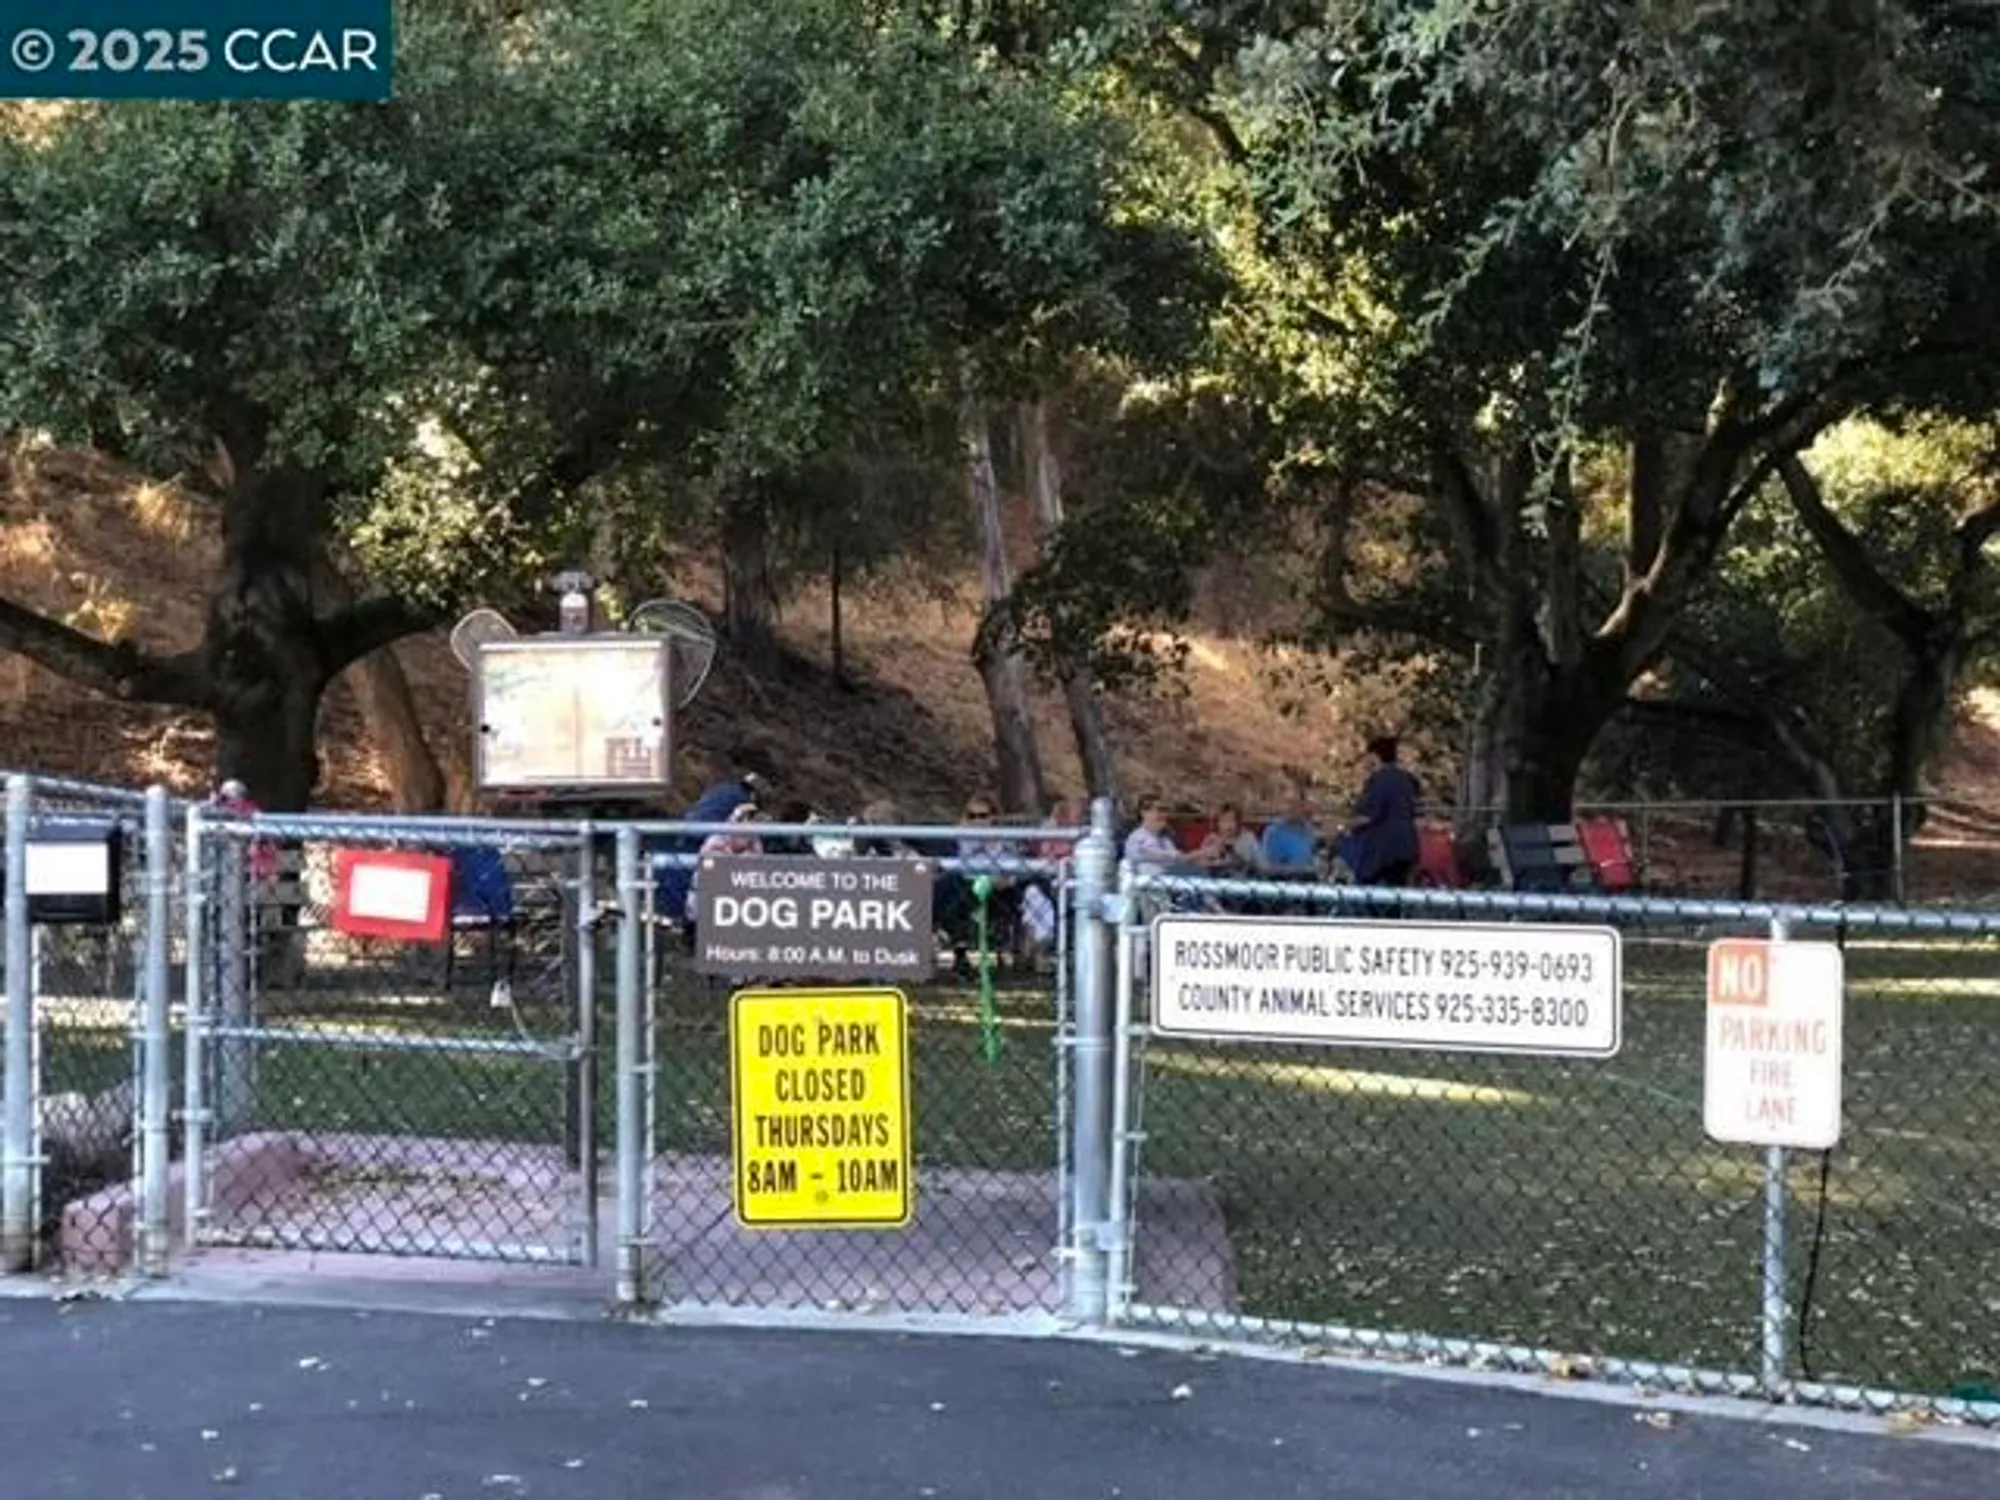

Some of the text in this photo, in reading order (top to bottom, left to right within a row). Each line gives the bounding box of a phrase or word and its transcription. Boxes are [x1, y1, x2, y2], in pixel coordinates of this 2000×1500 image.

[730, 871, 899, 892] WELCOME TO THE
[713, 897, 913, 931] DOG PARK
[852, 948, 871, 965] to
[874, 947, 919, 966] Dusk
[1174, 940, 1593, 983] ROSSMOOR PUBLIC SAFETY 925-939-0693
[1718, 954, 1763, 998] NO
[1178, 982, 1589, 1027] COUNTY ANIMAL SERVICES 925-335-8300
[758, 1023, 880, 1057] DOG PARK
[1718, 1015, 1827, 1055] PARKING
[775, 1068, 865, 1101] CLOSED
[1750, 1059, 1792, 1089] FIRE
[1746, 1095, 1794, 1126] LANE
[756, 1112, 890, 1148] THURSDAYS
[747, 1160, 798, 1193] 8AM
[836, 1159, 898, 1193] 10AM
